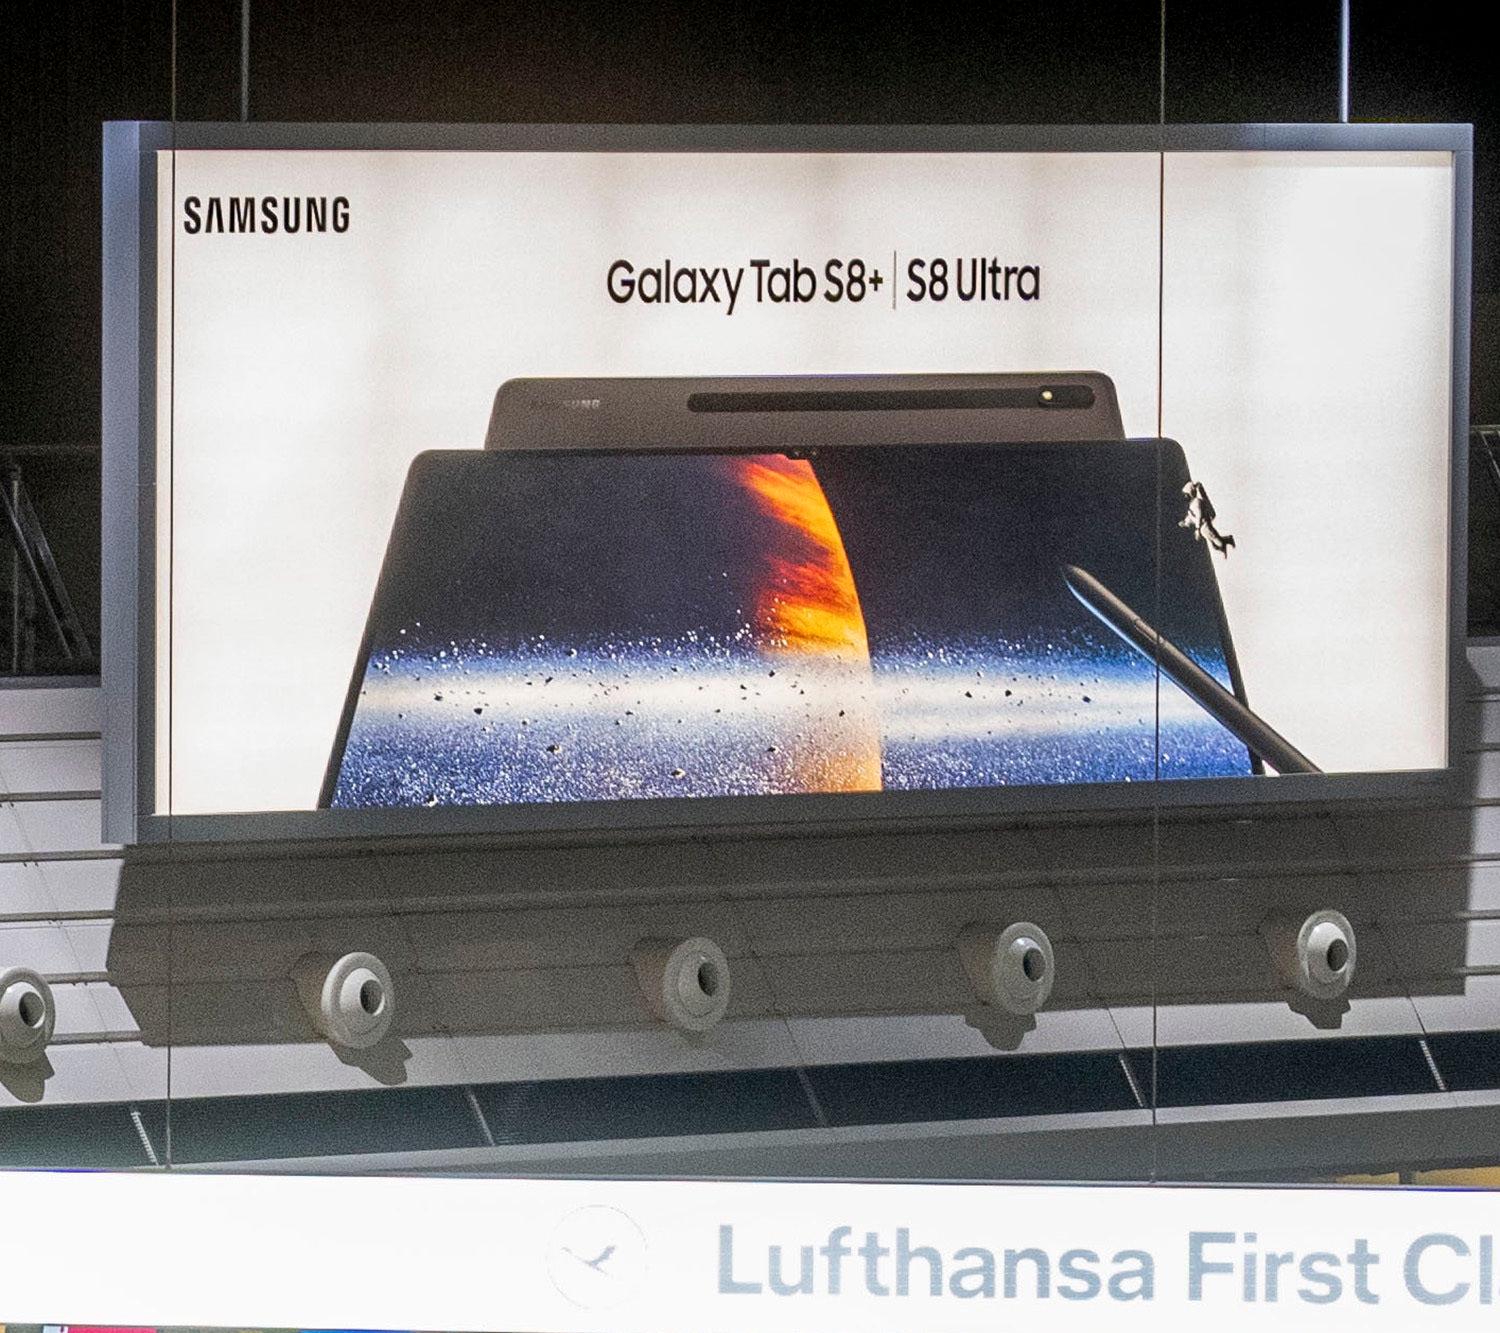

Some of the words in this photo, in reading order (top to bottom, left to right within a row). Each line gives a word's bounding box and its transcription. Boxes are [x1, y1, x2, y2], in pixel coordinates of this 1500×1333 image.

[182, 195, 351, 235] SAMSUNG
[606, 258, 745, 316] Galaxy
[749, 258, 817, 303] Tab
[823, 257, 884, 303] S8+
[906, 257, 949, 303] S8
[955, 256, 1042, 302] Ultra
[716, 1223, 1157, 1302] Lufthansa
[1187, 1230, 1381, 1304] First
